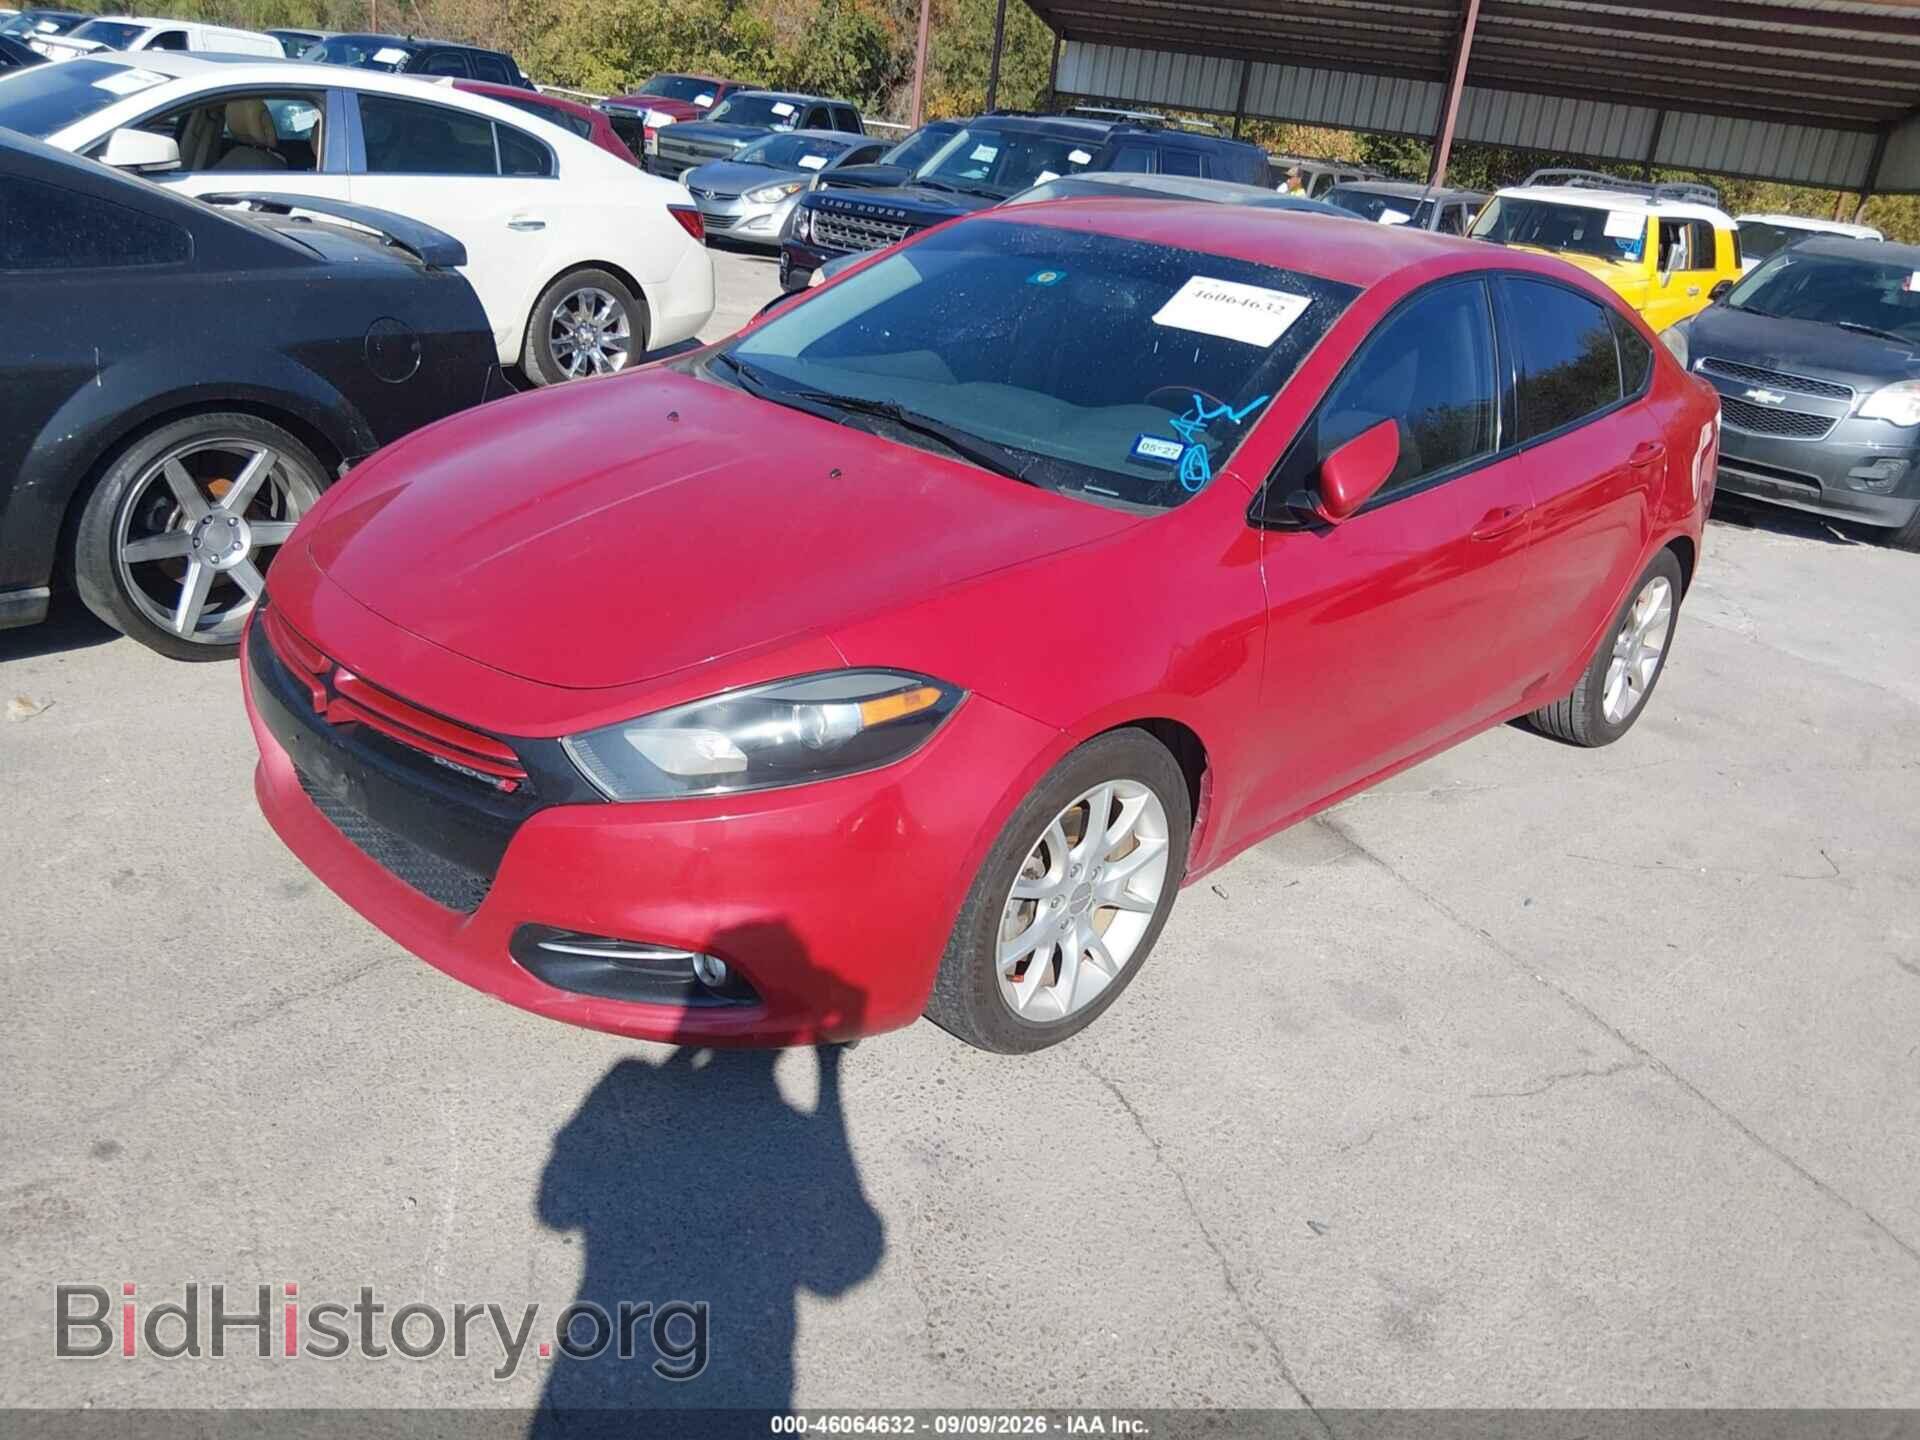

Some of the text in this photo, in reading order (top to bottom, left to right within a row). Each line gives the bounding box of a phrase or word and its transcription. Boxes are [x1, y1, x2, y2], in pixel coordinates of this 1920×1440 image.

[821, 198, 906, 218] LAND ROVER
[1193, 289, 1286, 316] 46064632
